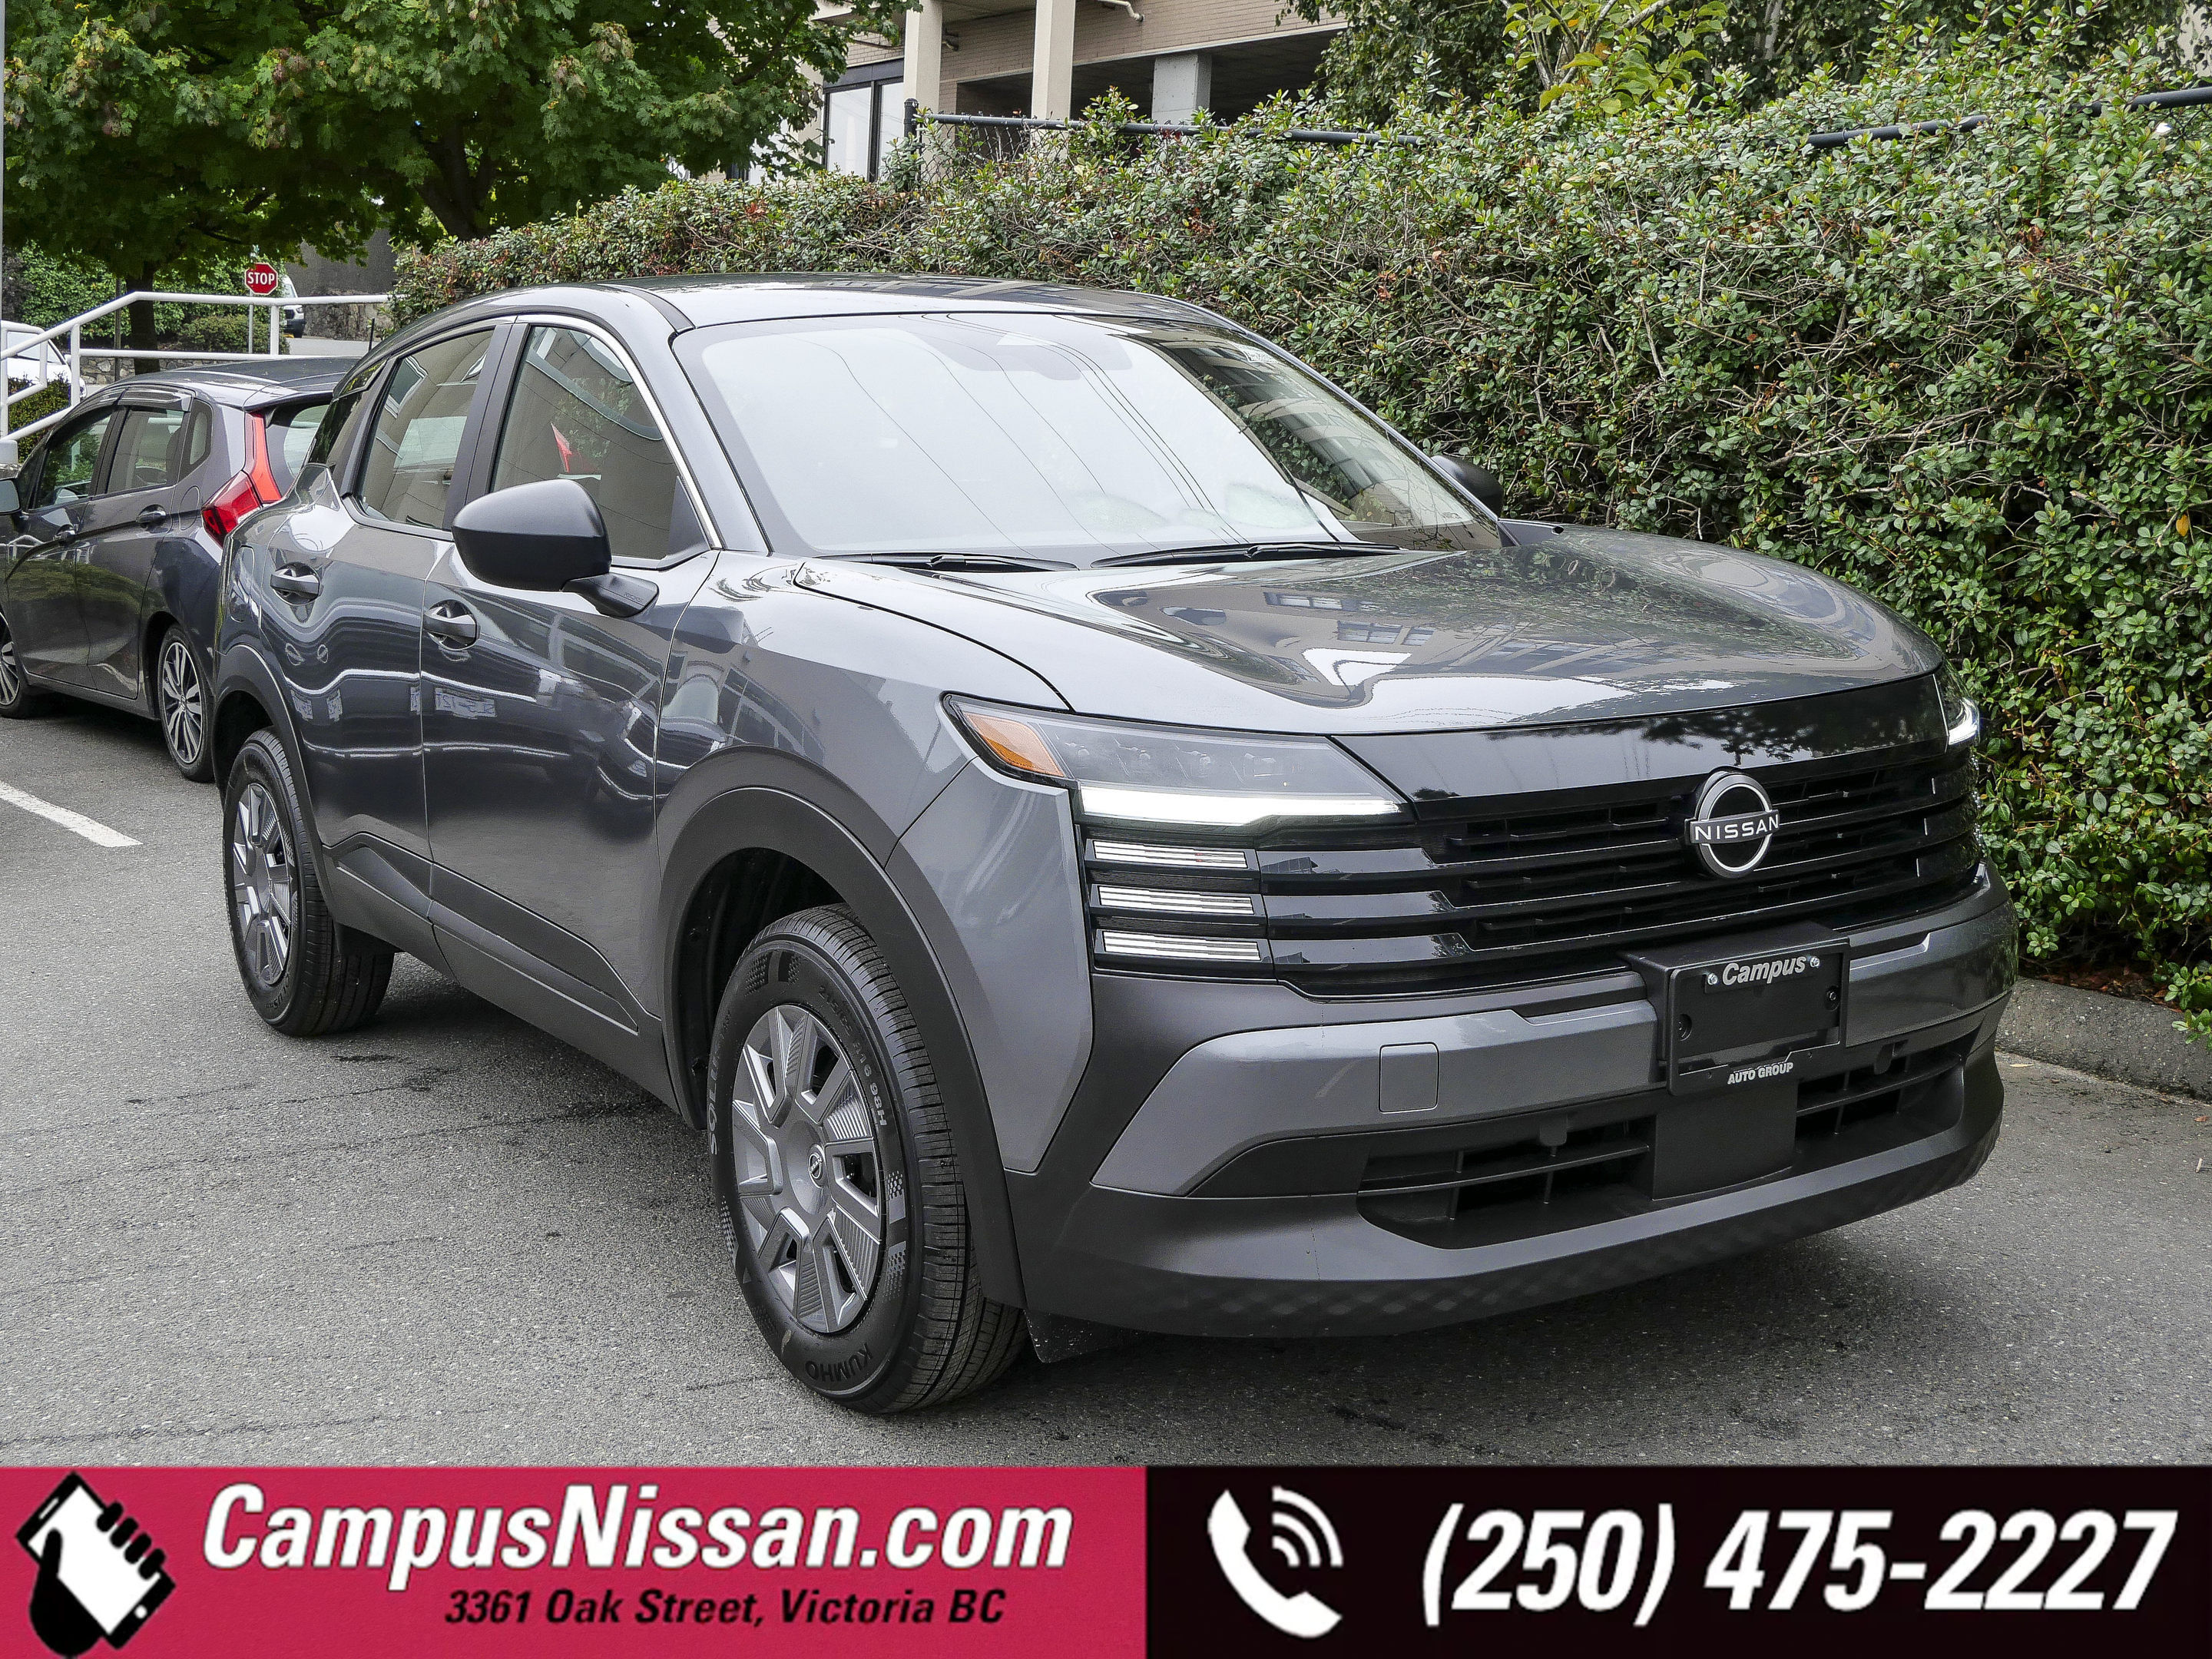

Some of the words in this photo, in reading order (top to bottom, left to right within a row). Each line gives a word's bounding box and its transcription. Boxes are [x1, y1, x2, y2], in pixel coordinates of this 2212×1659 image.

[247, 271, 275, 285] STOP
[1694, 814, 1779, 840] NISSAN
[1722, 956, 1806, 985] Campus
[853, 1041, 873, 1078] R16
[869, 1082, 888, 1126] 98H
[1727, 1068, 1756, 1084] AUTO
[1757, 1061, 1794, 1078] GROUP
[805, 1342, 873, 1382] KUMHO
